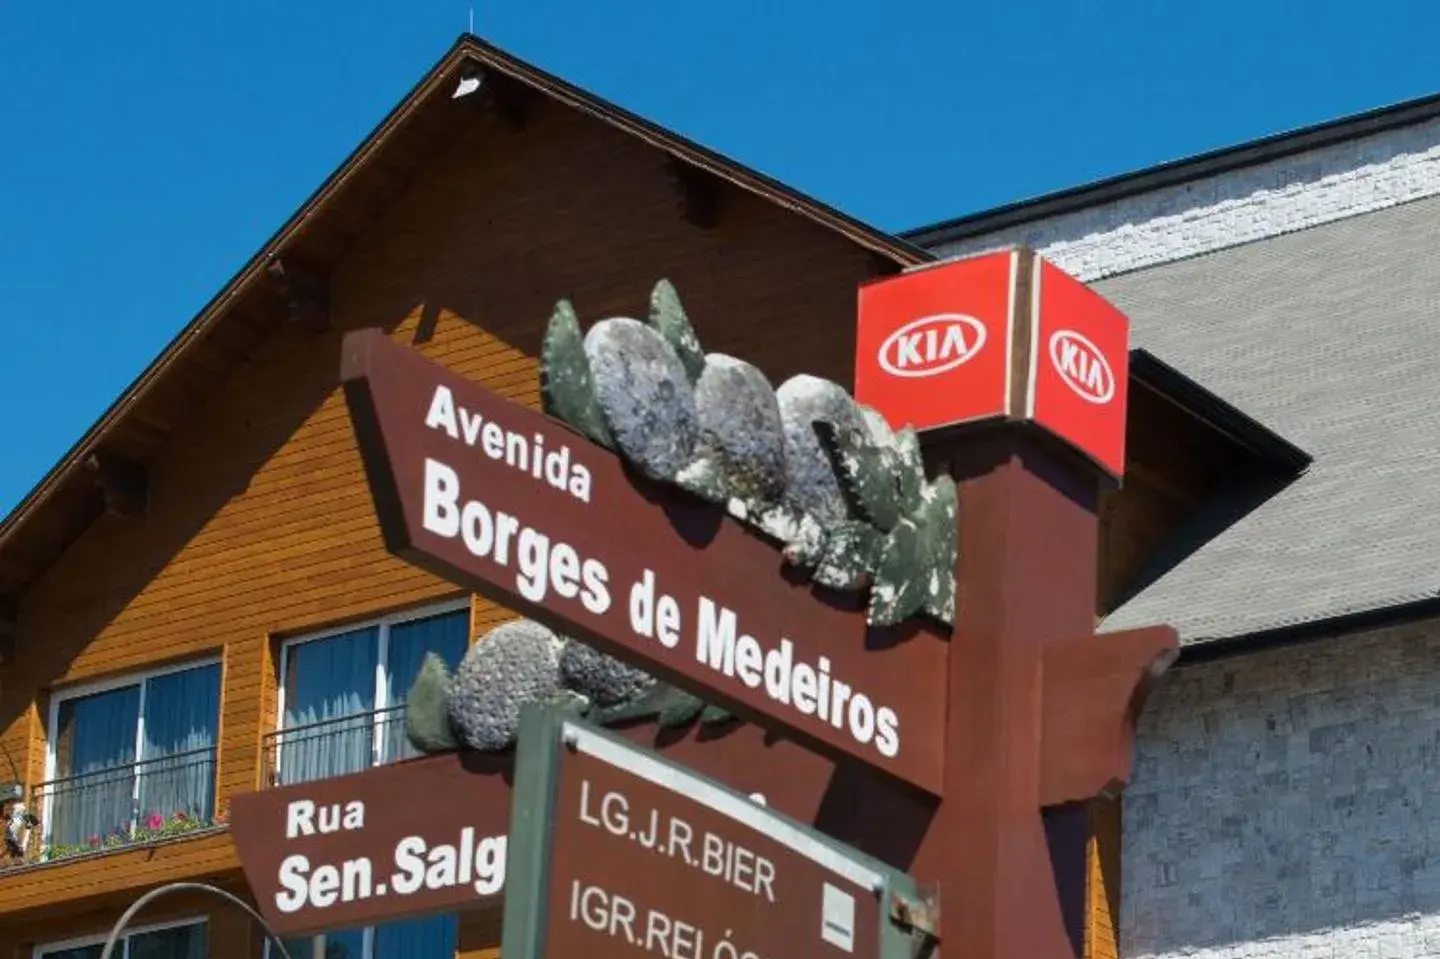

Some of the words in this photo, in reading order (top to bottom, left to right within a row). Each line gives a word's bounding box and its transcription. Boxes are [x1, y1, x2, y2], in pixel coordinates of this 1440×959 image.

[897, 323, 969, 368] KIA
[1060, 336, 1105, 397] KIA
[426, 384, 592, 502] Avenida
[422, 457, 612, 615] Borges
[629, 568, 681, 648] de
[696, 596, 900, 758] Medeiros
[286, 799, 365, 839] Rua
